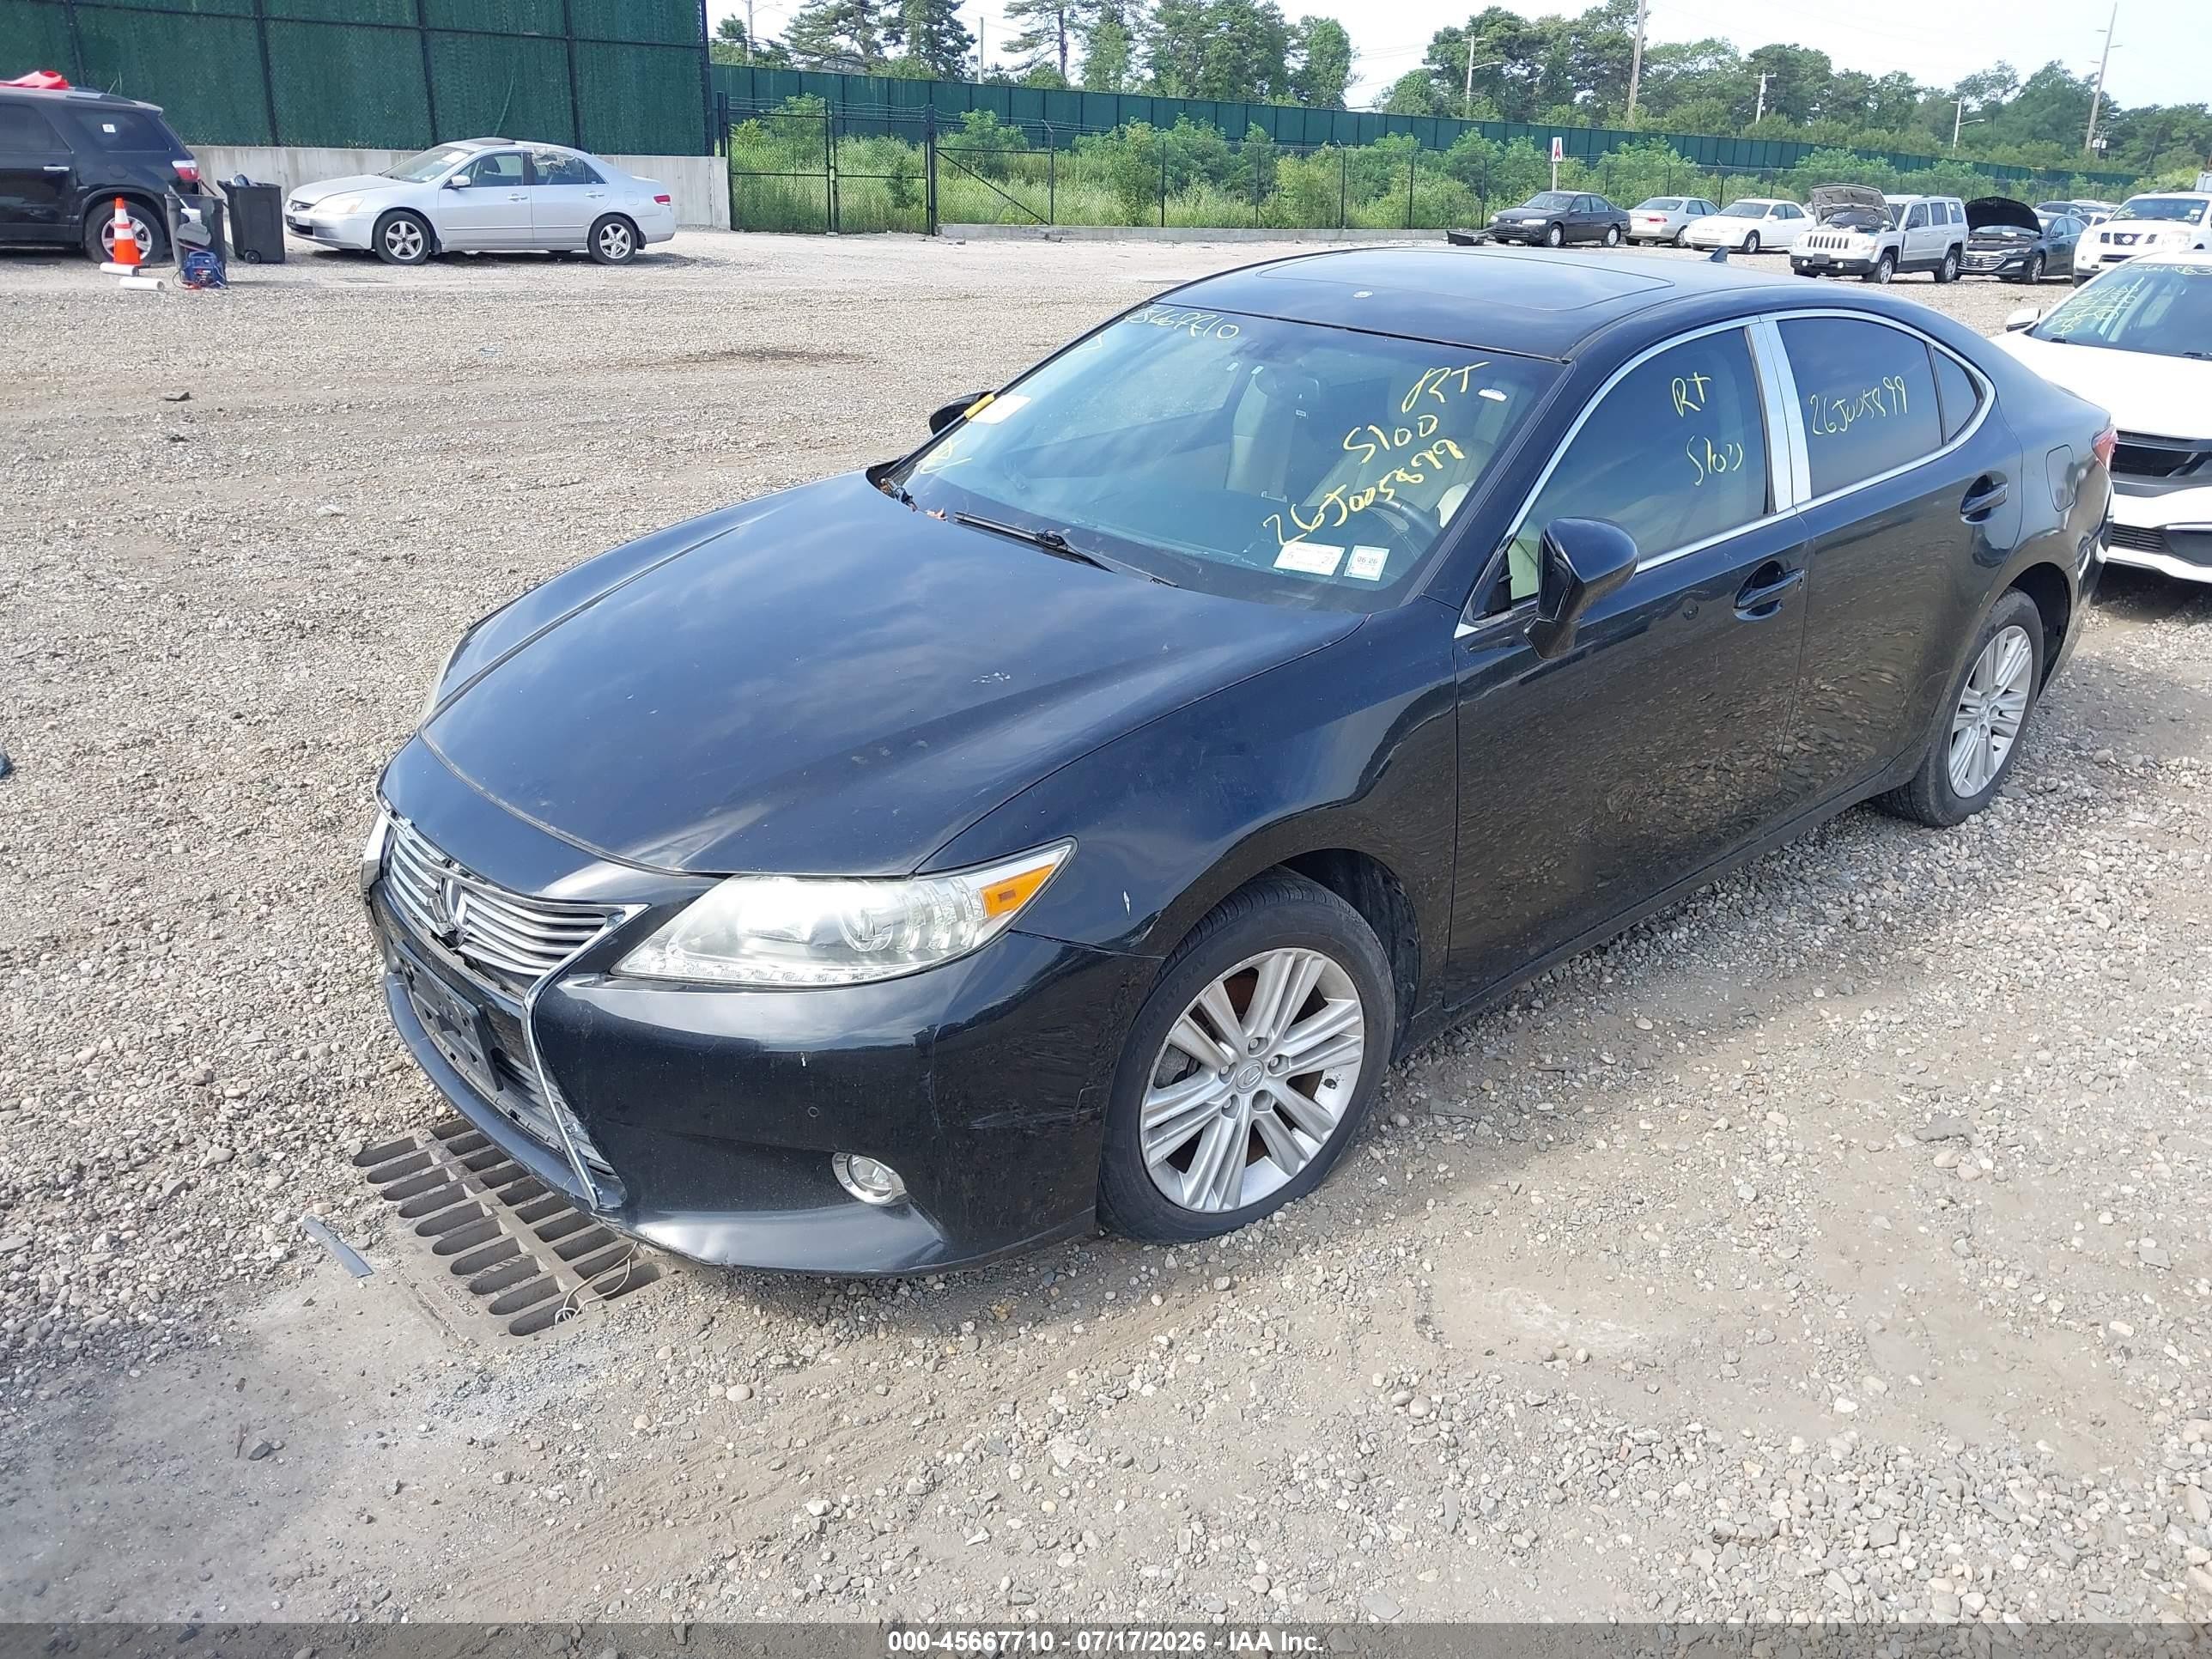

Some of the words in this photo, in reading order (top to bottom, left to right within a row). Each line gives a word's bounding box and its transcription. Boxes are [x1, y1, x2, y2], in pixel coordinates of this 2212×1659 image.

[1554, 137, 1561, 160] A
[1672, 371, 1711, 418] RT
[1262, 439, 1466, 545] 26J005899
